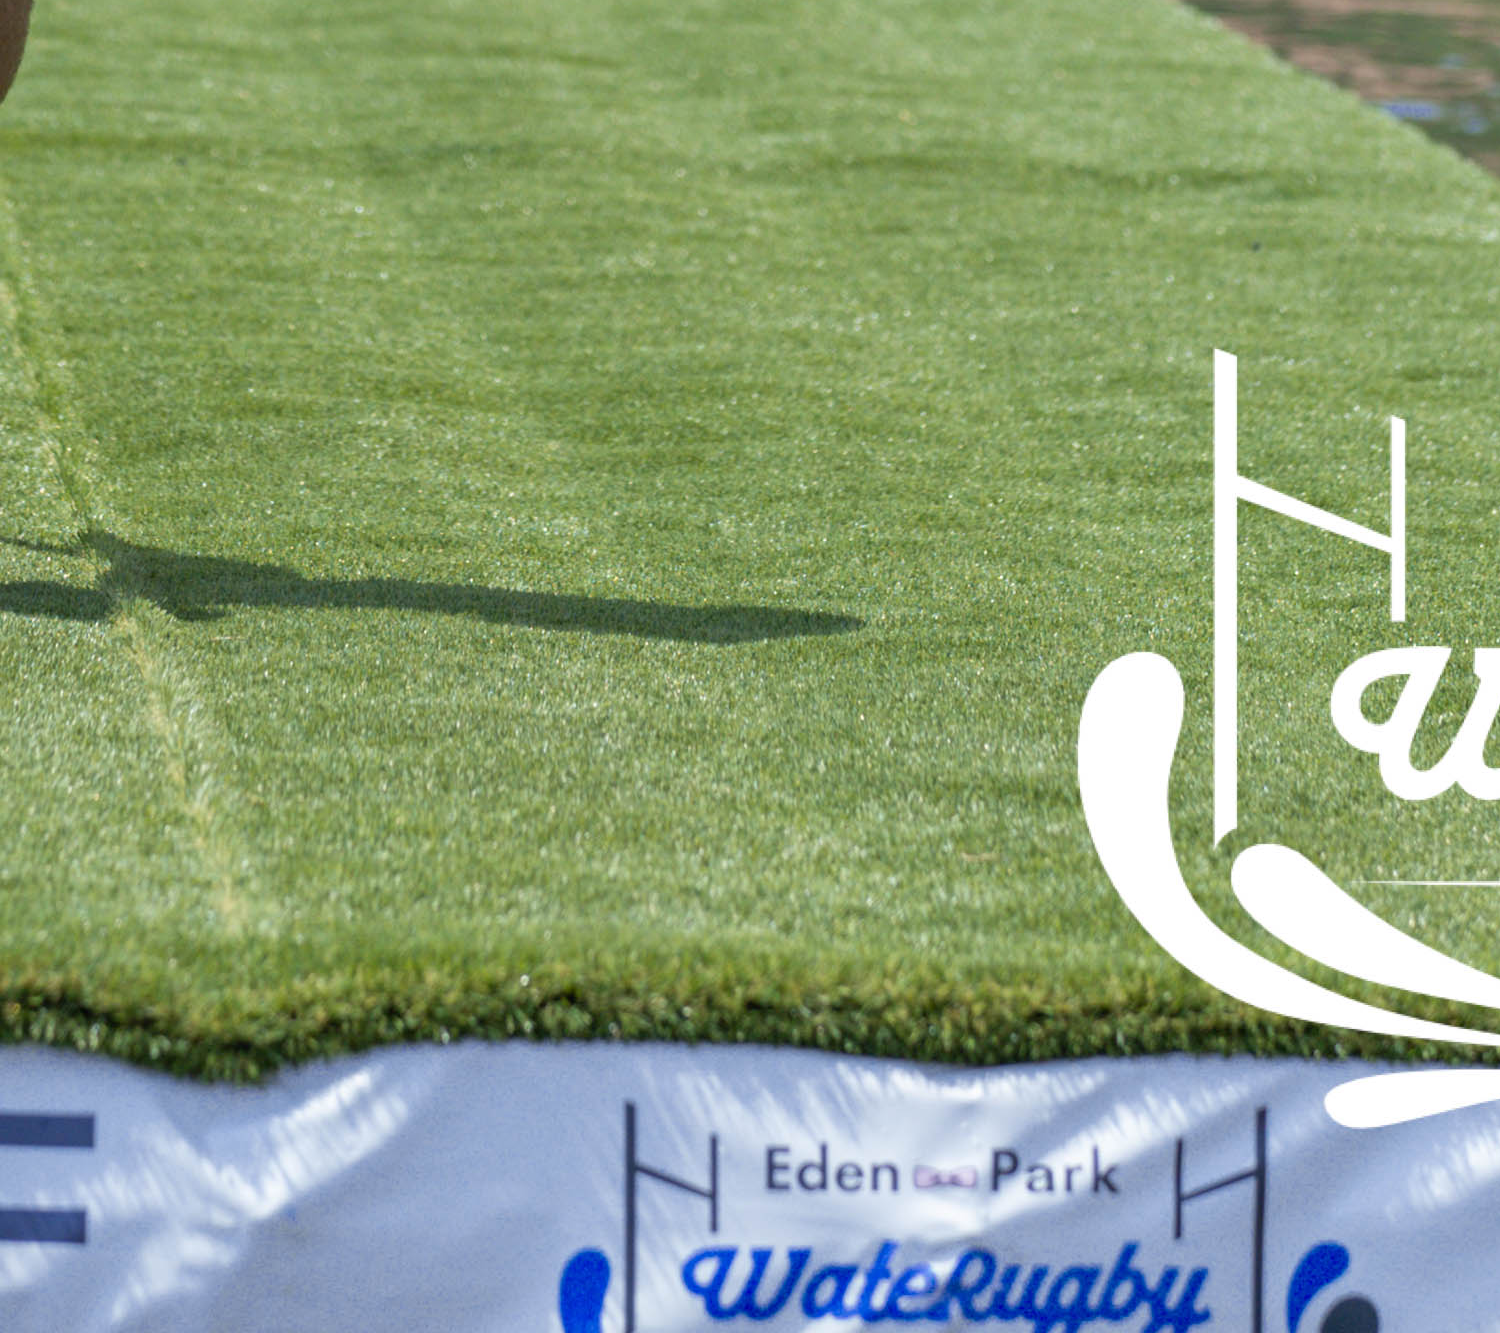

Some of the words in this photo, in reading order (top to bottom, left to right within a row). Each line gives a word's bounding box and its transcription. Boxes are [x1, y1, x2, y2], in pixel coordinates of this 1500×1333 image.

[764, 1142, 901, 1192] Eden
[990, 1145, 1121, 1195] Park
[680, 1241, 1211, 1333] WateRugby
